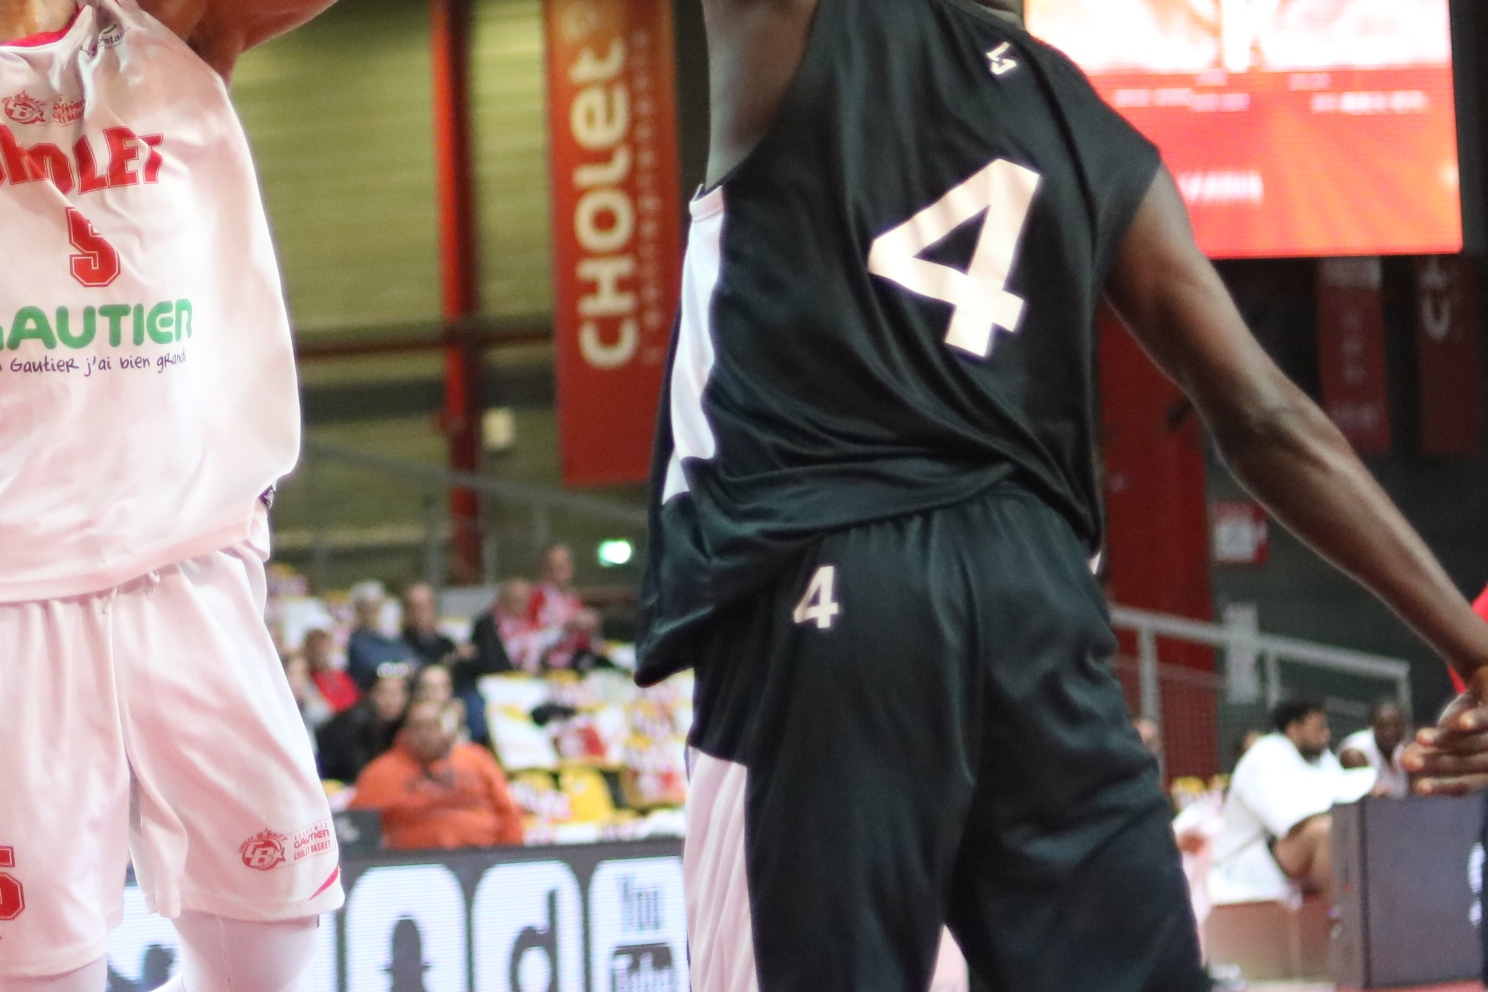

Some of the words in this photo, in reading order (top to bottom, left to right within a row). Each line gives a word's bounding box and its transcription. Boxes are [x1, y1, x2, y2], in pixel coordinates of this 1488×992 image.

[65, 206, 121, 288] 5
[868, 158, 1041, 360] 4
[120, 354, 151, 370] bien
[793, 565, 839, 629] 4
